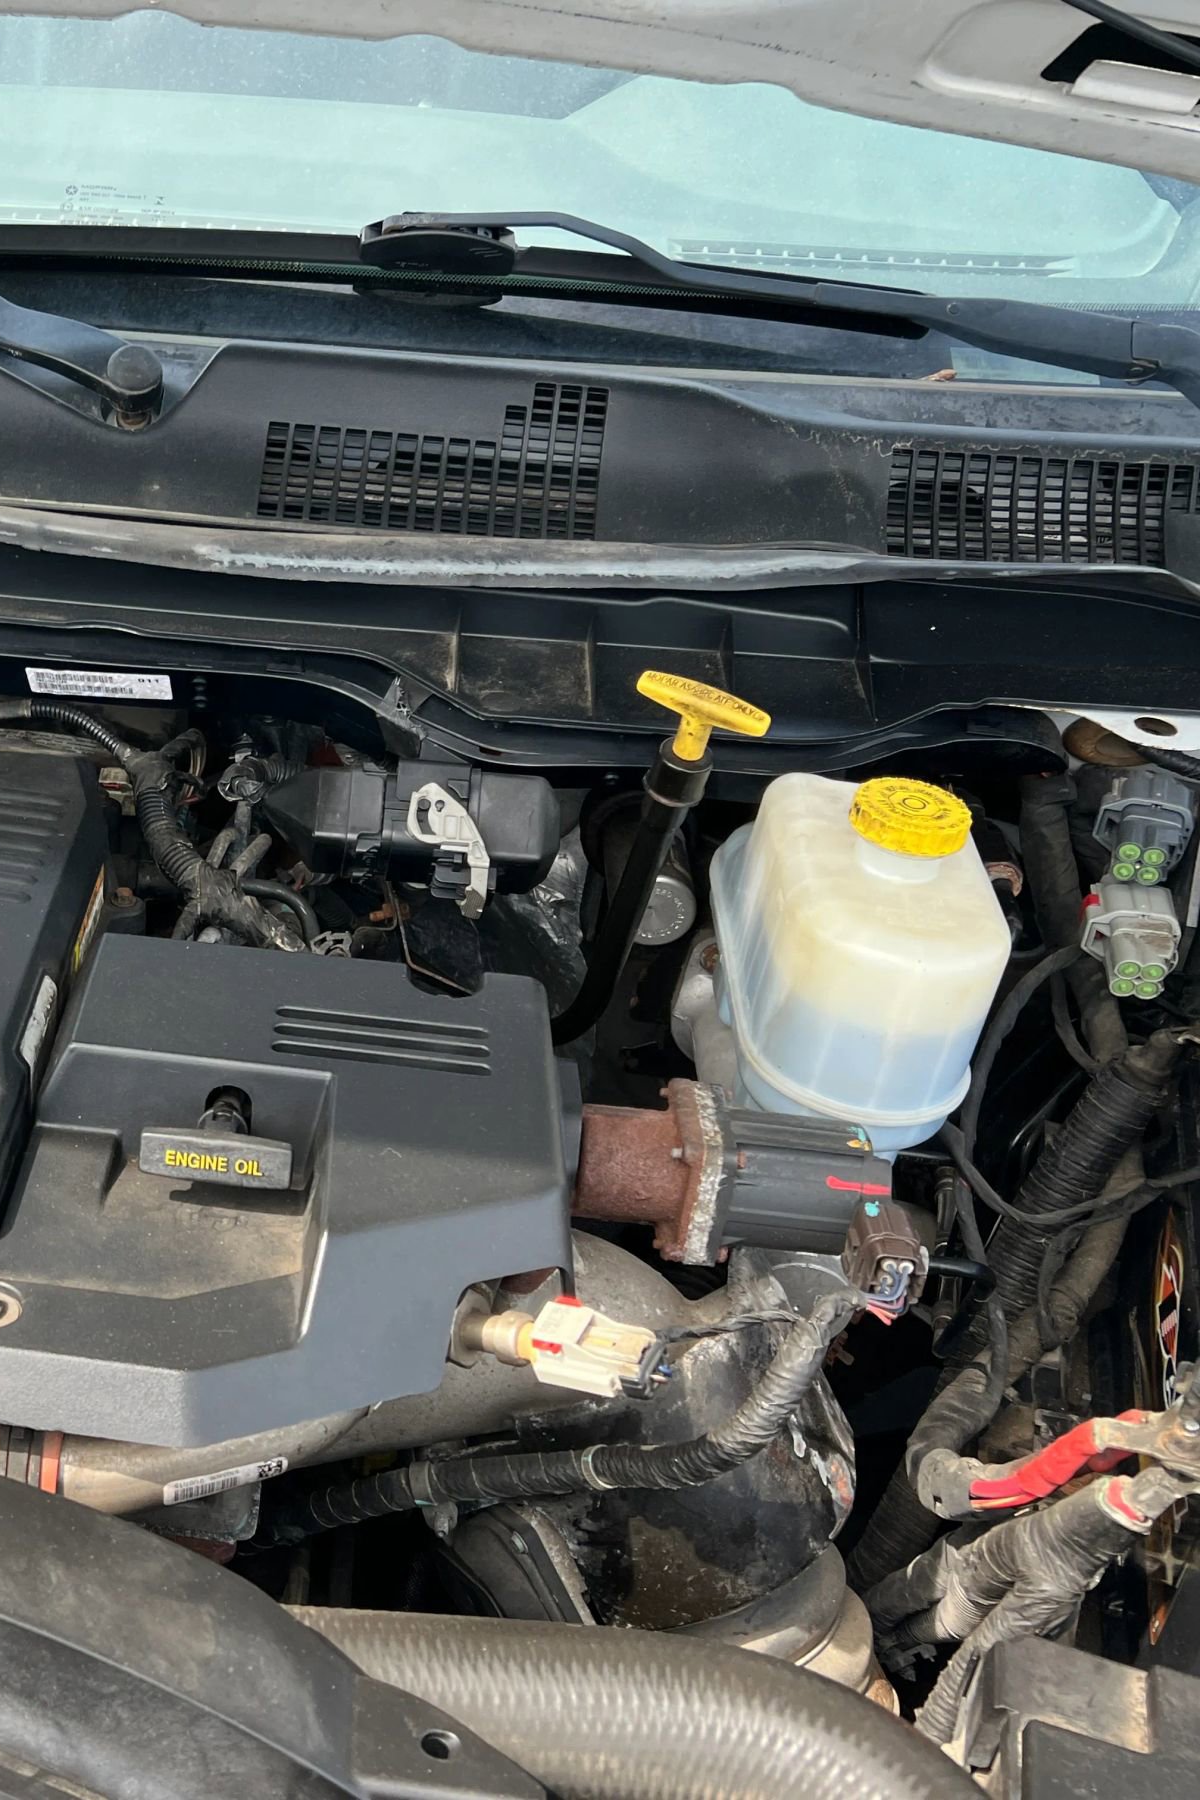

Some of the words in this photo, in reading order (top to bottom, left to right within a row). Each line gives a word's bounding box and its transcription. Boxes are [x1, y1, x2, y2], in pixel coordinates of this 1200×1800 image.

[647, 672, 679, 687] MOPAR
[714, 695, 731, 705] ATF
[731, 702, 755, 716] ONLY
[165, 1149, 228, 1172] ENGINE
[234, 1158, 263, 1177] OIL
